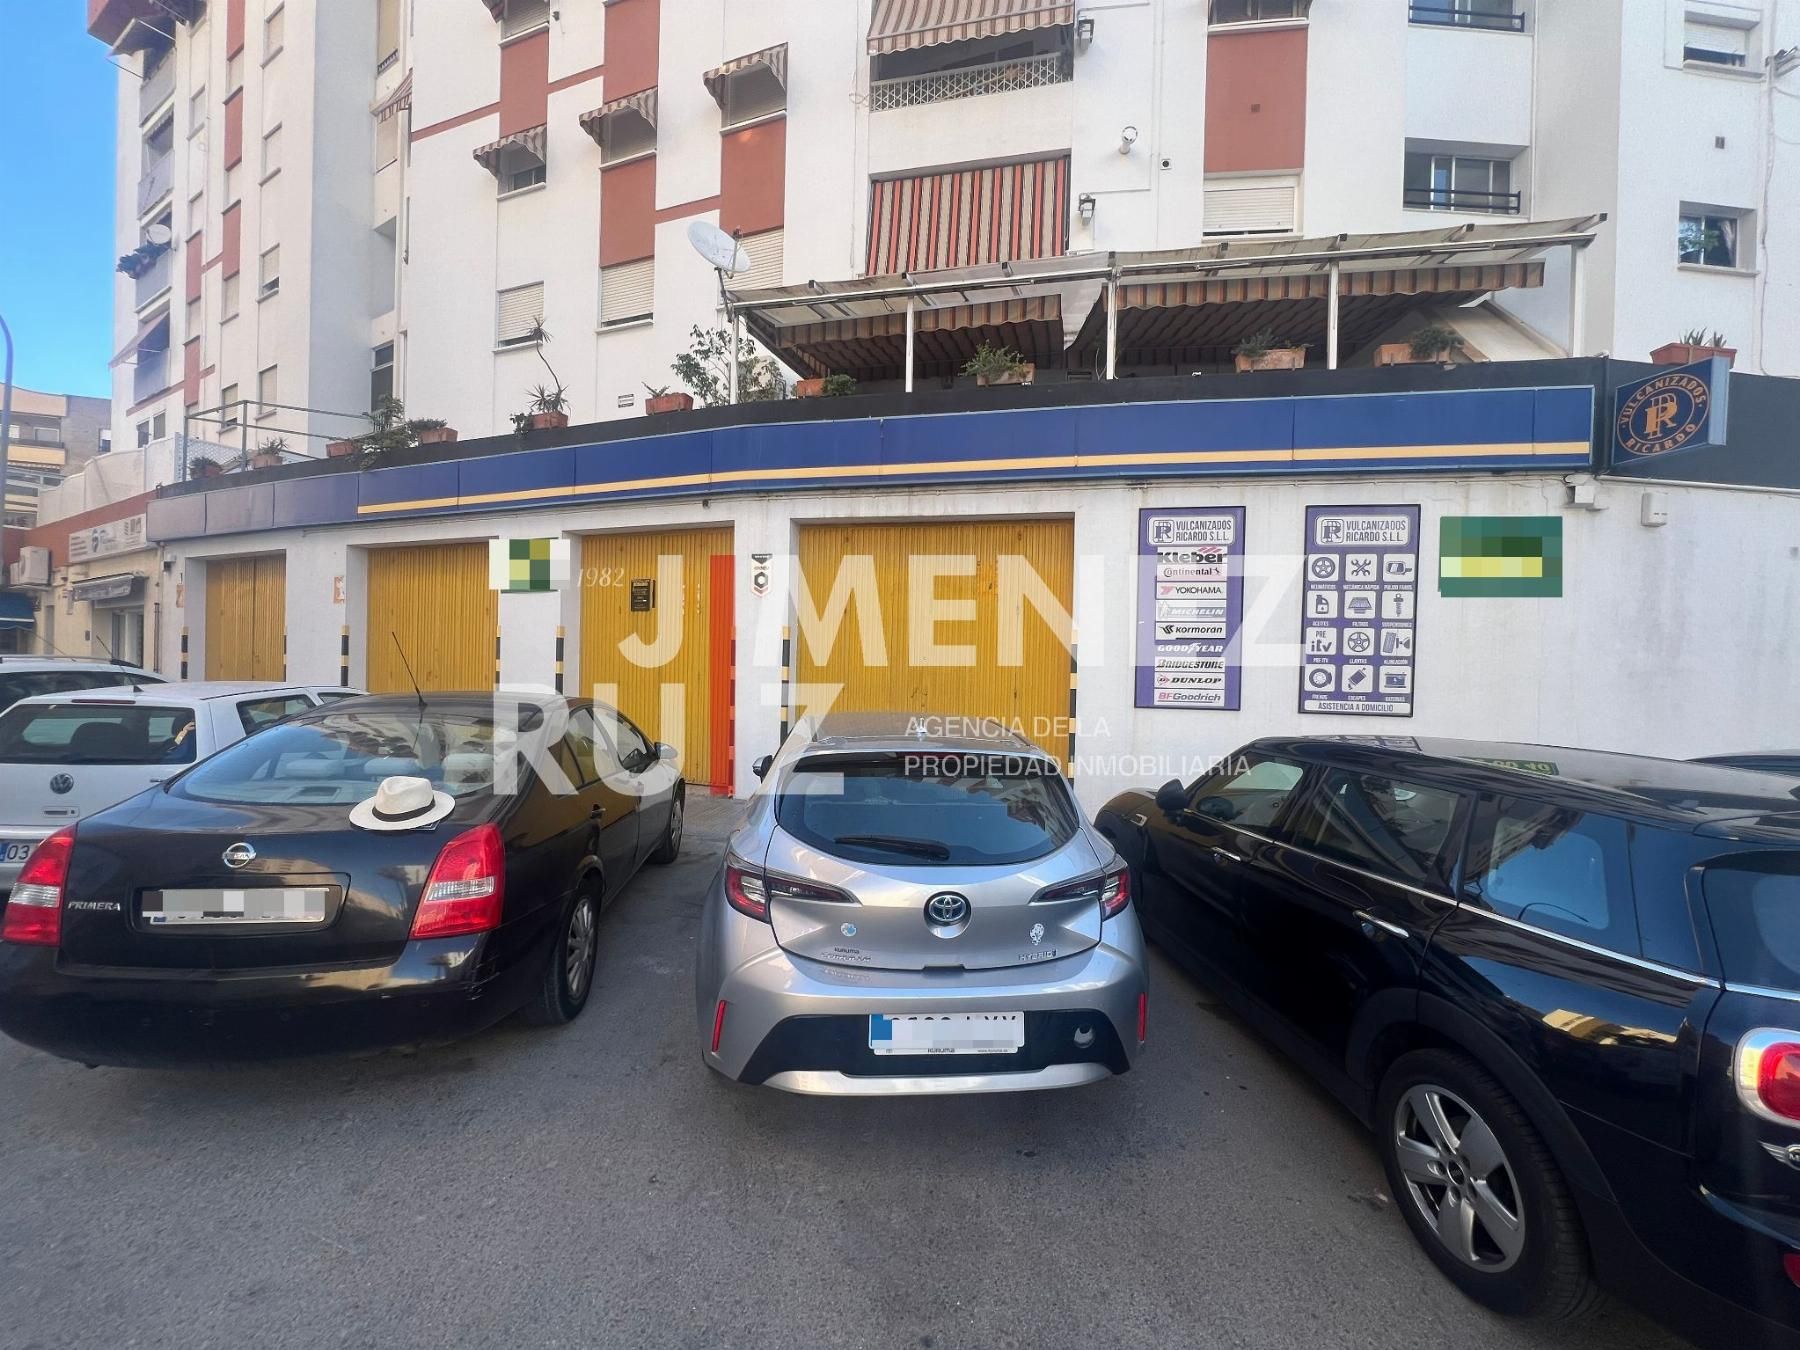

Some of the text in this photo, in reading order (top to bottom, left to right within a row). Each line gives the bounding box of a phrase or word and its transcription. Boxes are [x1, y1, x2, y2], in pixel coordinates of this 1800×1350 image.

[1620, 376, 1706, 424] VULCANIZADOS
[1625, 423, 1697, 453] RICARDO
[1176, 520, 1231, 530] VULCANIZADOS
[1346, 520, 1406, 530] VULCANIZADOS
[1176, 531, 1230, 541] RICARDO S.L.L.
[1346, 531, 1380, 541] RICARDO
[1157, 551, 1227, 563] Kleber
[1163, 567, 1212, 577] Continental
[577, 567, 625, 588] 1982
[1175, 586, 1222, 594] YOKOHAMA
[1171, 608, 1224, 616] MICHELIN
[1315, 630, 1326, 638] PRE
[1157, 642, 1224, 654] GOODYEAR
[1156, 659, 1224, 669] BRIDGESTONE
[1158, 691, 1221, 701] BFGoodrich
[1318, 702, 1394, 712] ASISTENCIA A DOMICILIO
[68, 901, 120, 911] PRIMERA
